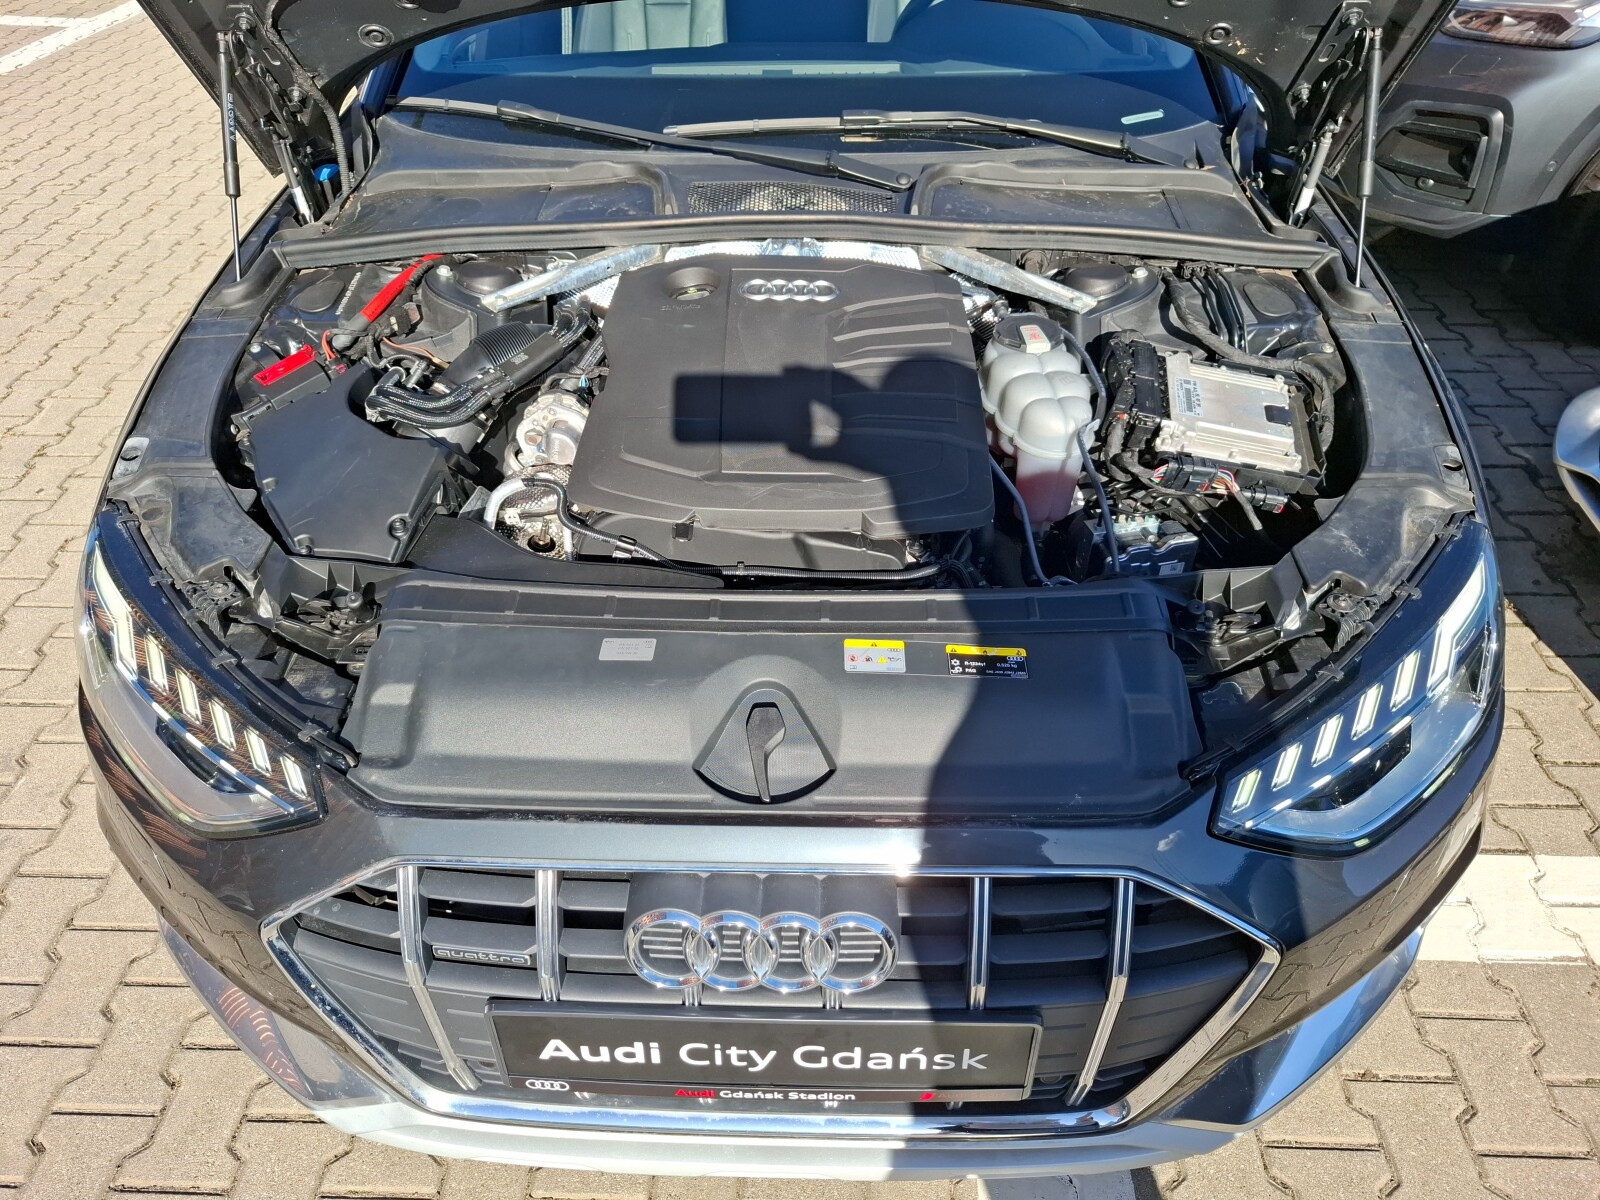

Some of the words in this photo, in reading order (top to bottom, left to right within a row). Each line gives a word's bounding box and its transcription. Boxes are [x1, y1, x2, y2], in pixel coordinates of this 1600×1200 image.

[437, 949, 525, 964] quattro
[538, 1038, 661, 1064] Audi
[678, 1042, 777, 1072] City
[792, 1044, 989, 1070] Gdańsk
[674, 1088, 716, 1098] Audi
[719, 1089, 785, 1100] Gdańsk
[788, 1091, 856, 1101] Stadion
